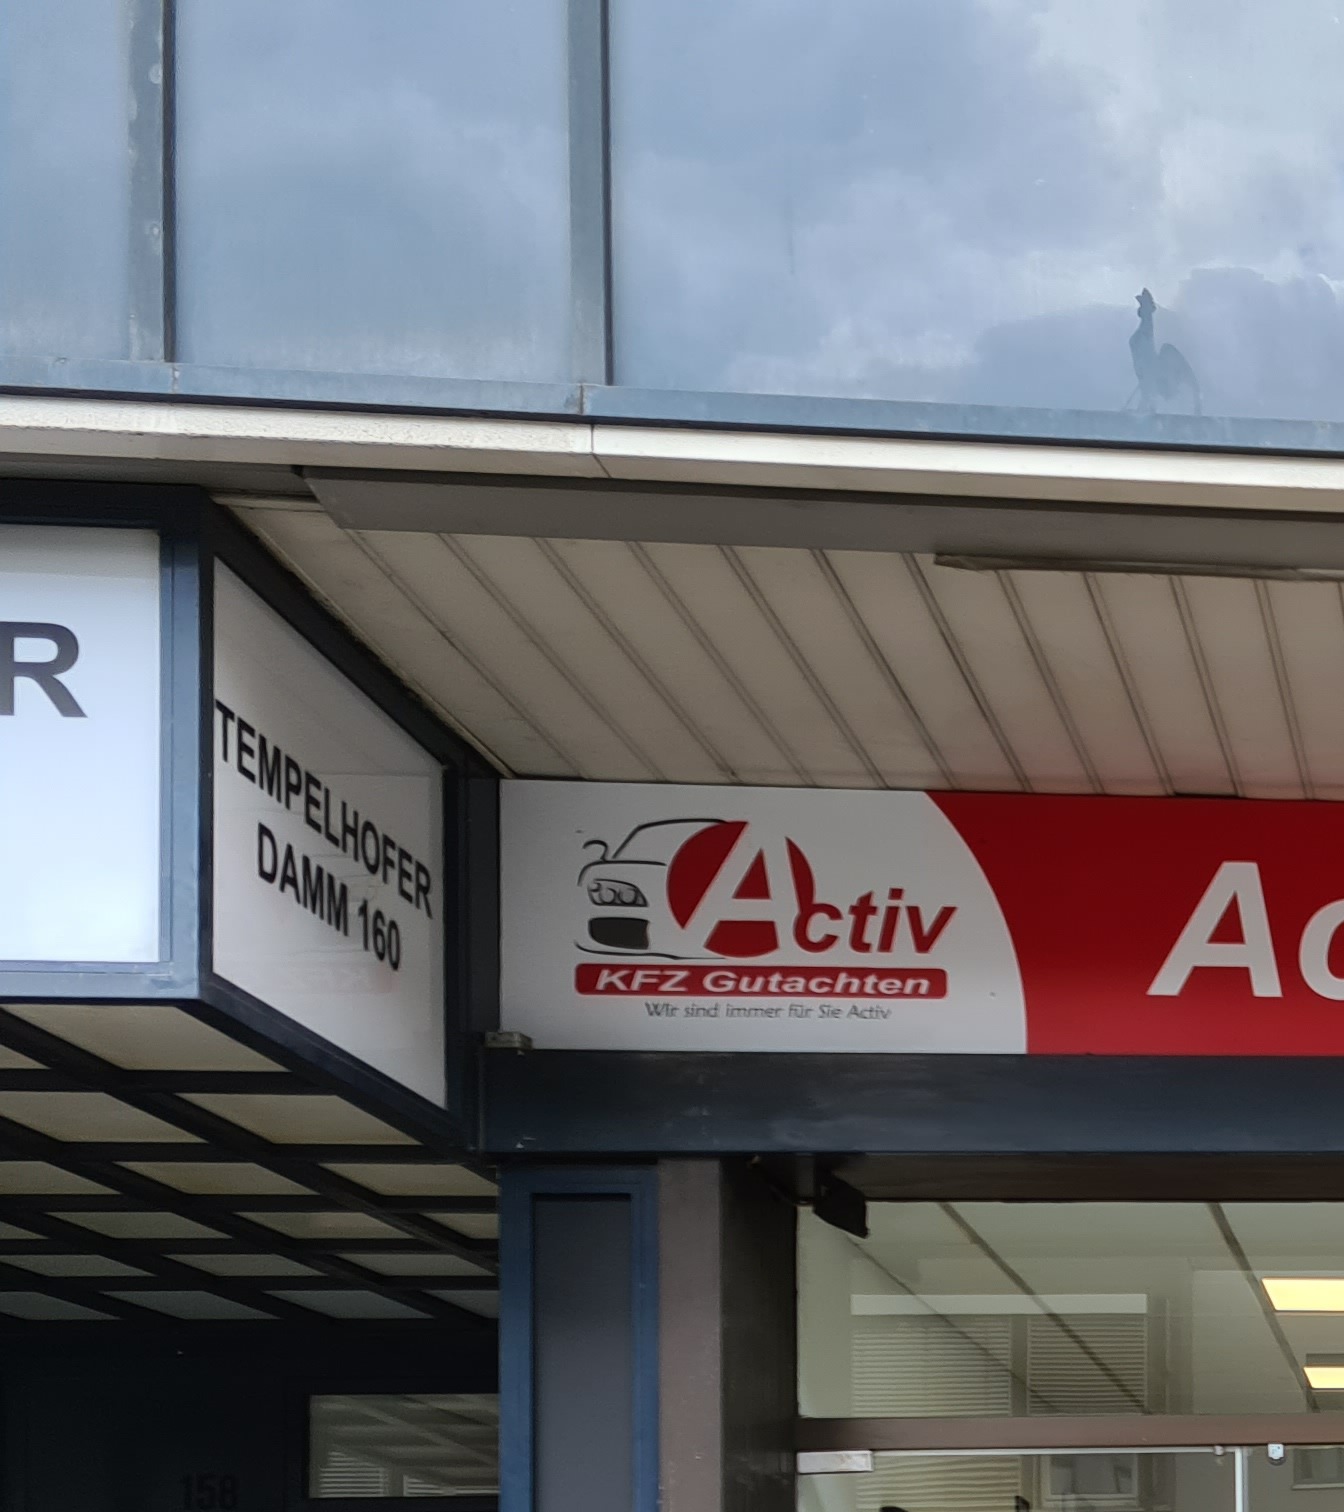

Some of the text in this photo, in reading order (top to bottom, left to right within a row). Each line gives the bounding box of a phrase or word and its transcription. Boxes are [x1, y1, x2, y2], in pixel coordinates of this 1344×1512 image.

[214, 699, 434, 920] TEMPELHOFER
[256, 822, 402, 972] DAMM 160
[683, 820, 958, 957] Activ
[595, 968, 931, 997] KFZ Gutachten
[645, 1002, 893, 1020] Wir sind immer für Sie Activ
